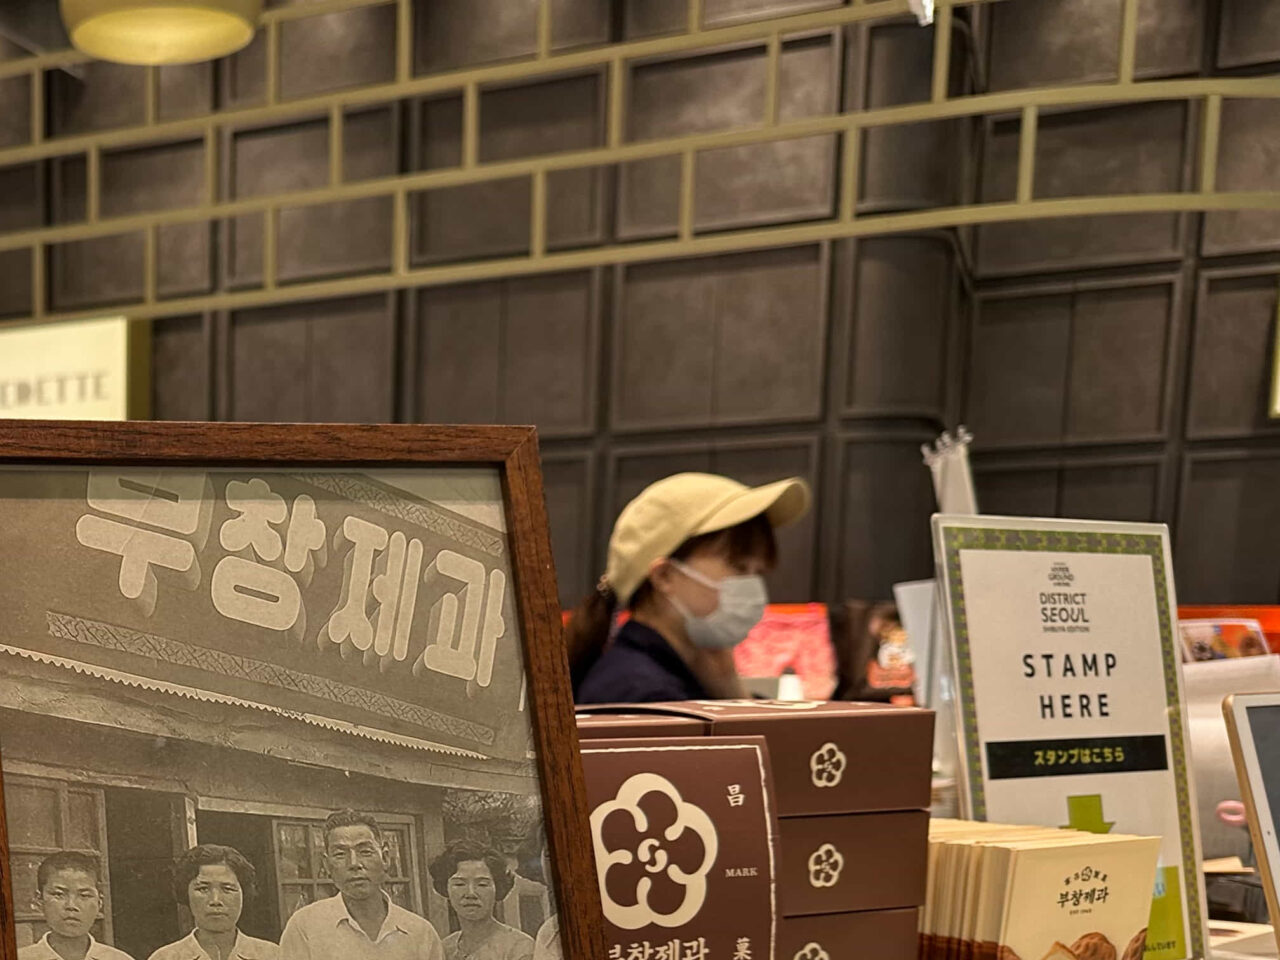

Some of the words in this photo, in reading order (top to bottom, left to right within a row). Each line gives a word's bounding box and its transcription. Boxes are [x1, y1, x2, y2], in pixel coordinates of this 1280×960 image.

[76, 472, 506, 688] 부창제과
[1039, 592, 1086, 605] DISTRICT
[1041, 607, 1089, 623] SEOUL
[1023, 653, 1117, 678] STAMP
[1040, 694, 1110, 719] HERE
[1033, 746, 1125, 766] スタンプはこちら
[726, 784, 746, 807] 昌
[725, 866, 759, 878] MARK
[1056, 886, 1109, 908] 부창제과
[733, 937, 752, 960] 菓
